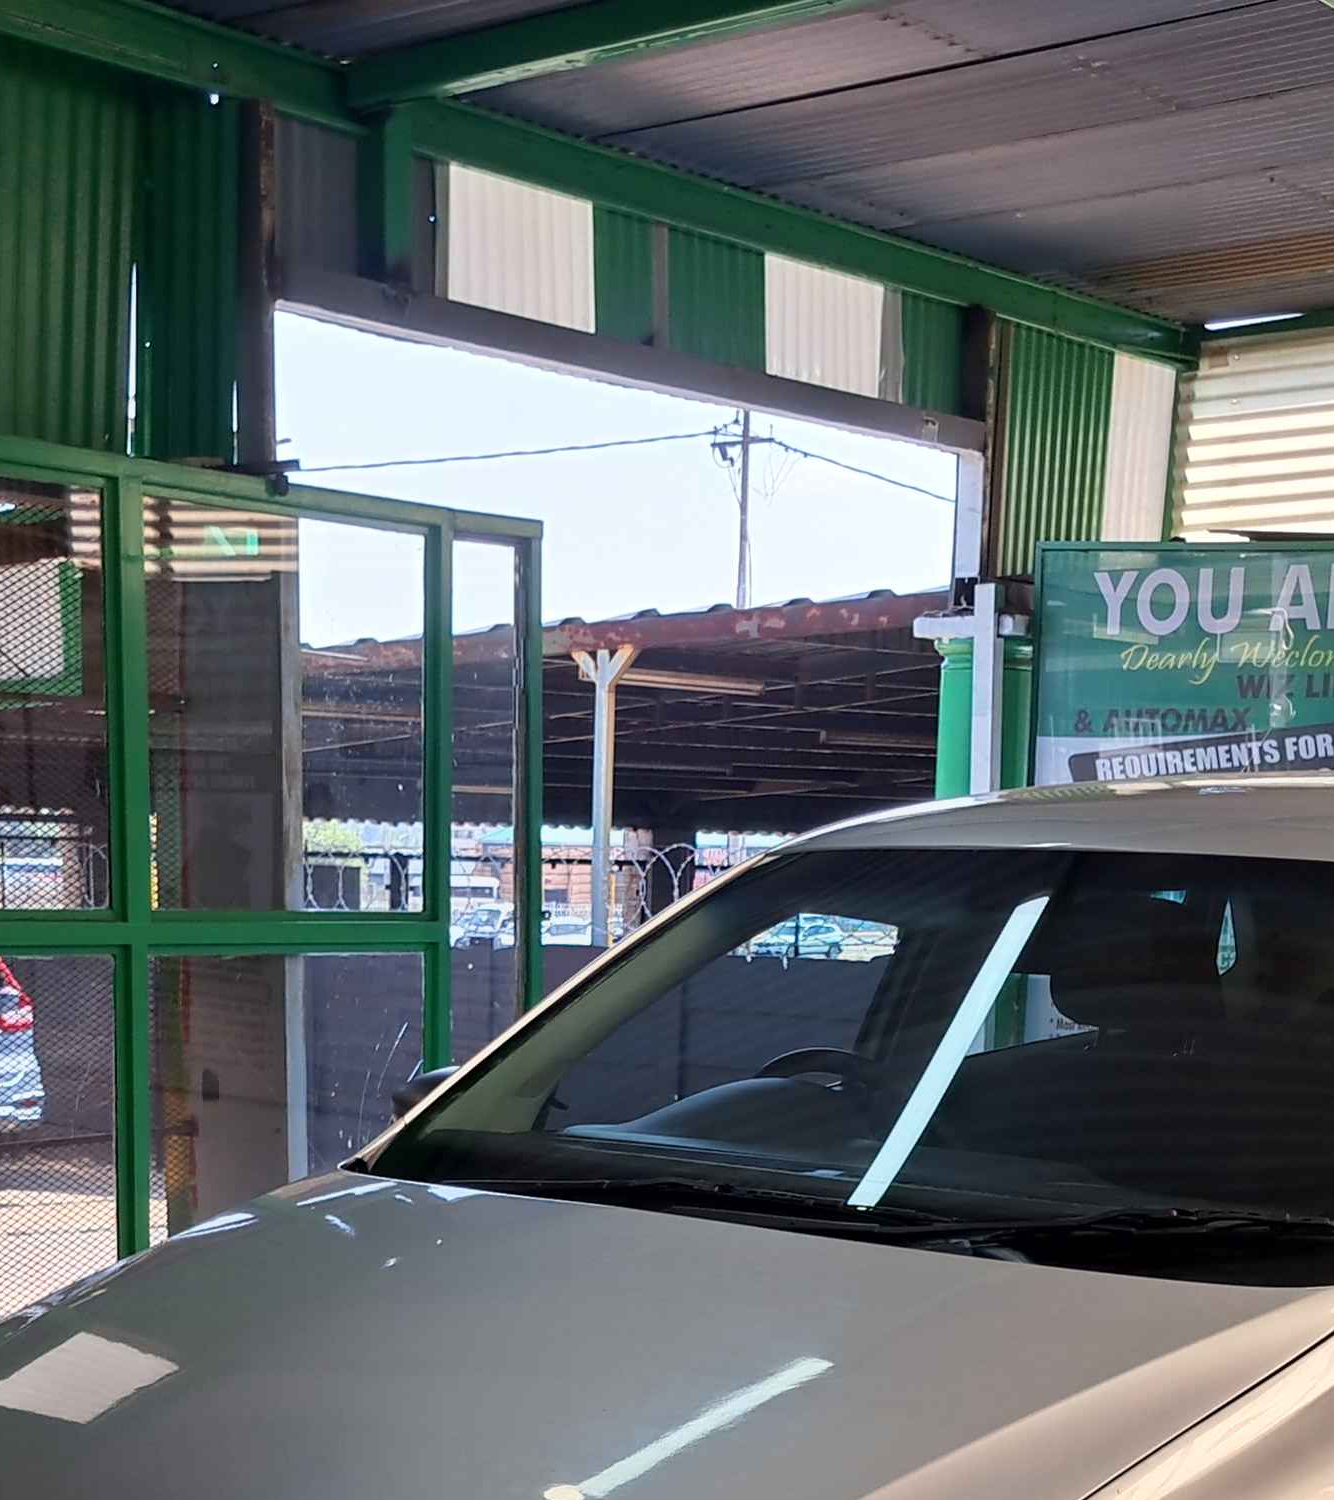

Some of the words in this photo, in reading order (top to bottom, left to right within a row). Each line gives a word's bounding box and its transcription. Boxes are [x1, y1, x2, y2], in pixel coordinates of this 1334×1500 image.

[1093, 567, 1245, 636] YOU
[1121, 636, 1218, 685] Dearly
[1236, 674, 1296, 699] WIZ
[1074, 709, 1092, 733] &
[1103, 706, 1252, 733] AUTOMAX
[1284, 733, 1334, 761] FOR
